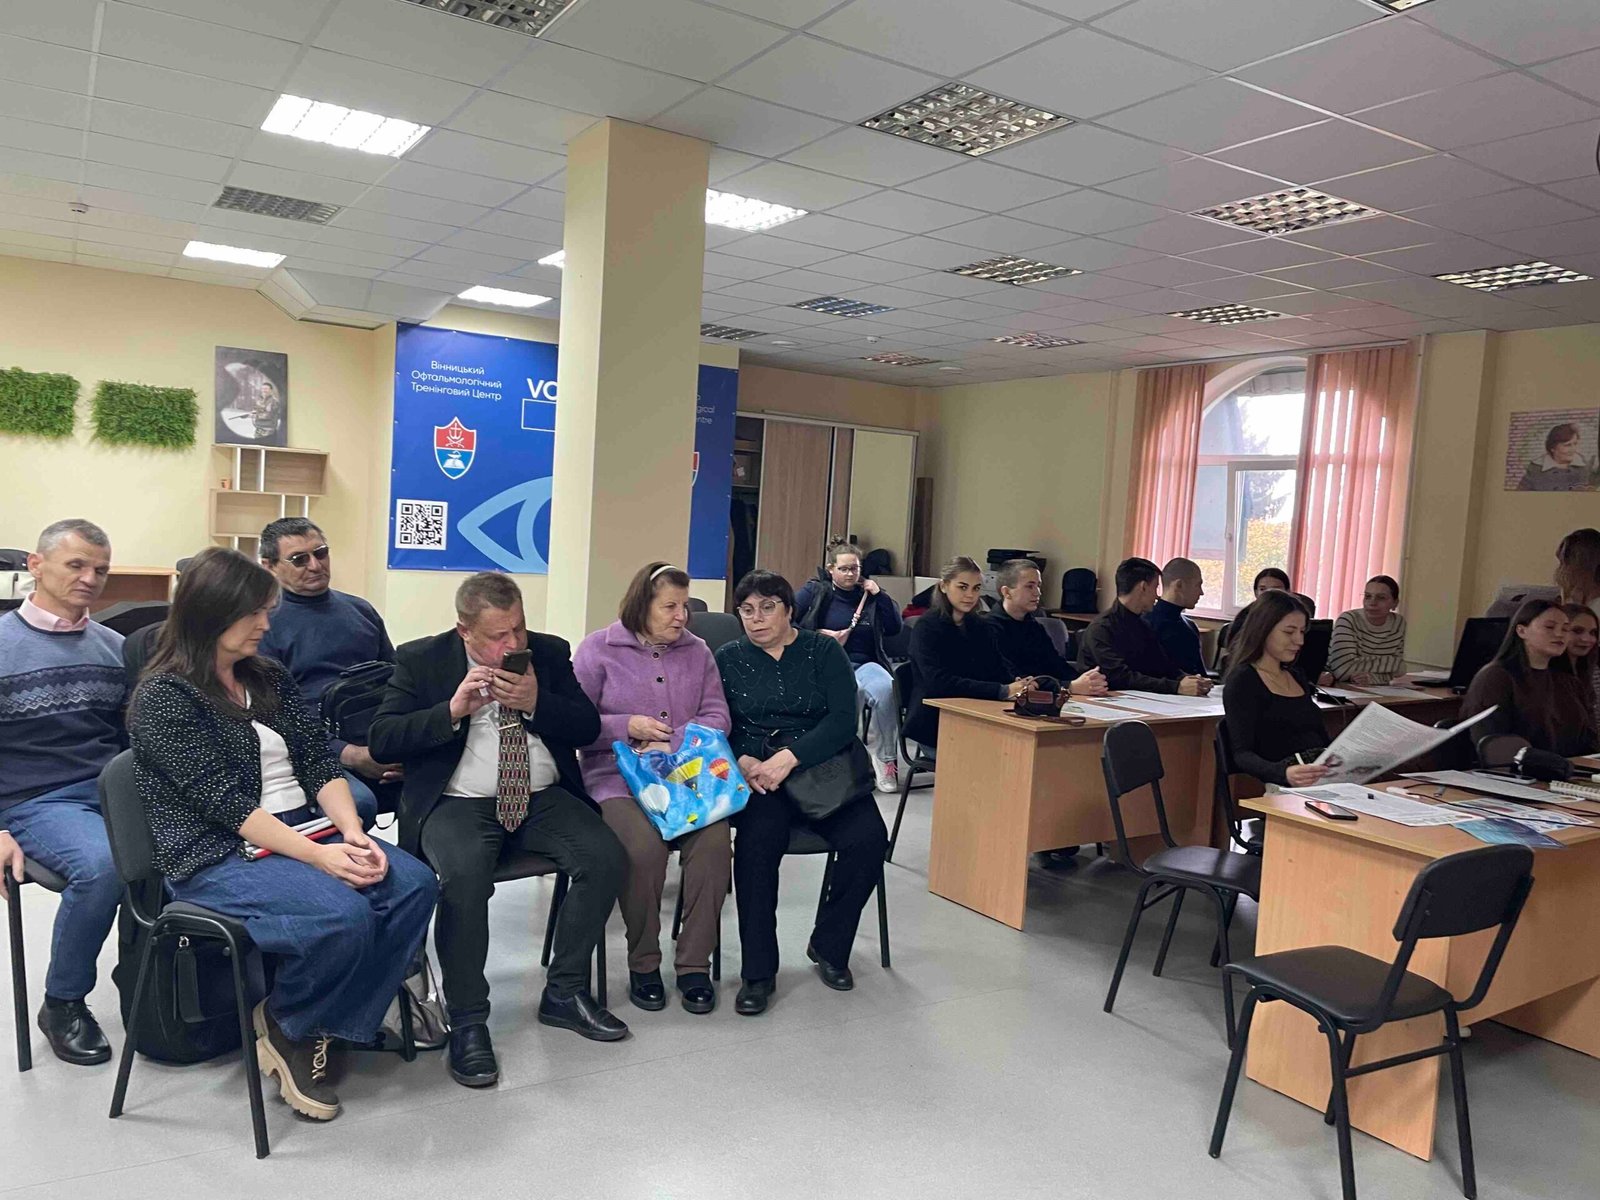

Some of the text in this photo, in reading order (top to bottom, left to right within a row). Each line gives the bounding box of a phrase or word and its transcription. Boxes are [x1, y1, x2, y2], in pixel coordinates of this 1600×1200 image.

[431, 360, 485, 375] Вінницький
[411, 369, 502, 389] Офтальмологічний
[411, 381, 502, 402] Тренінговий Центр
